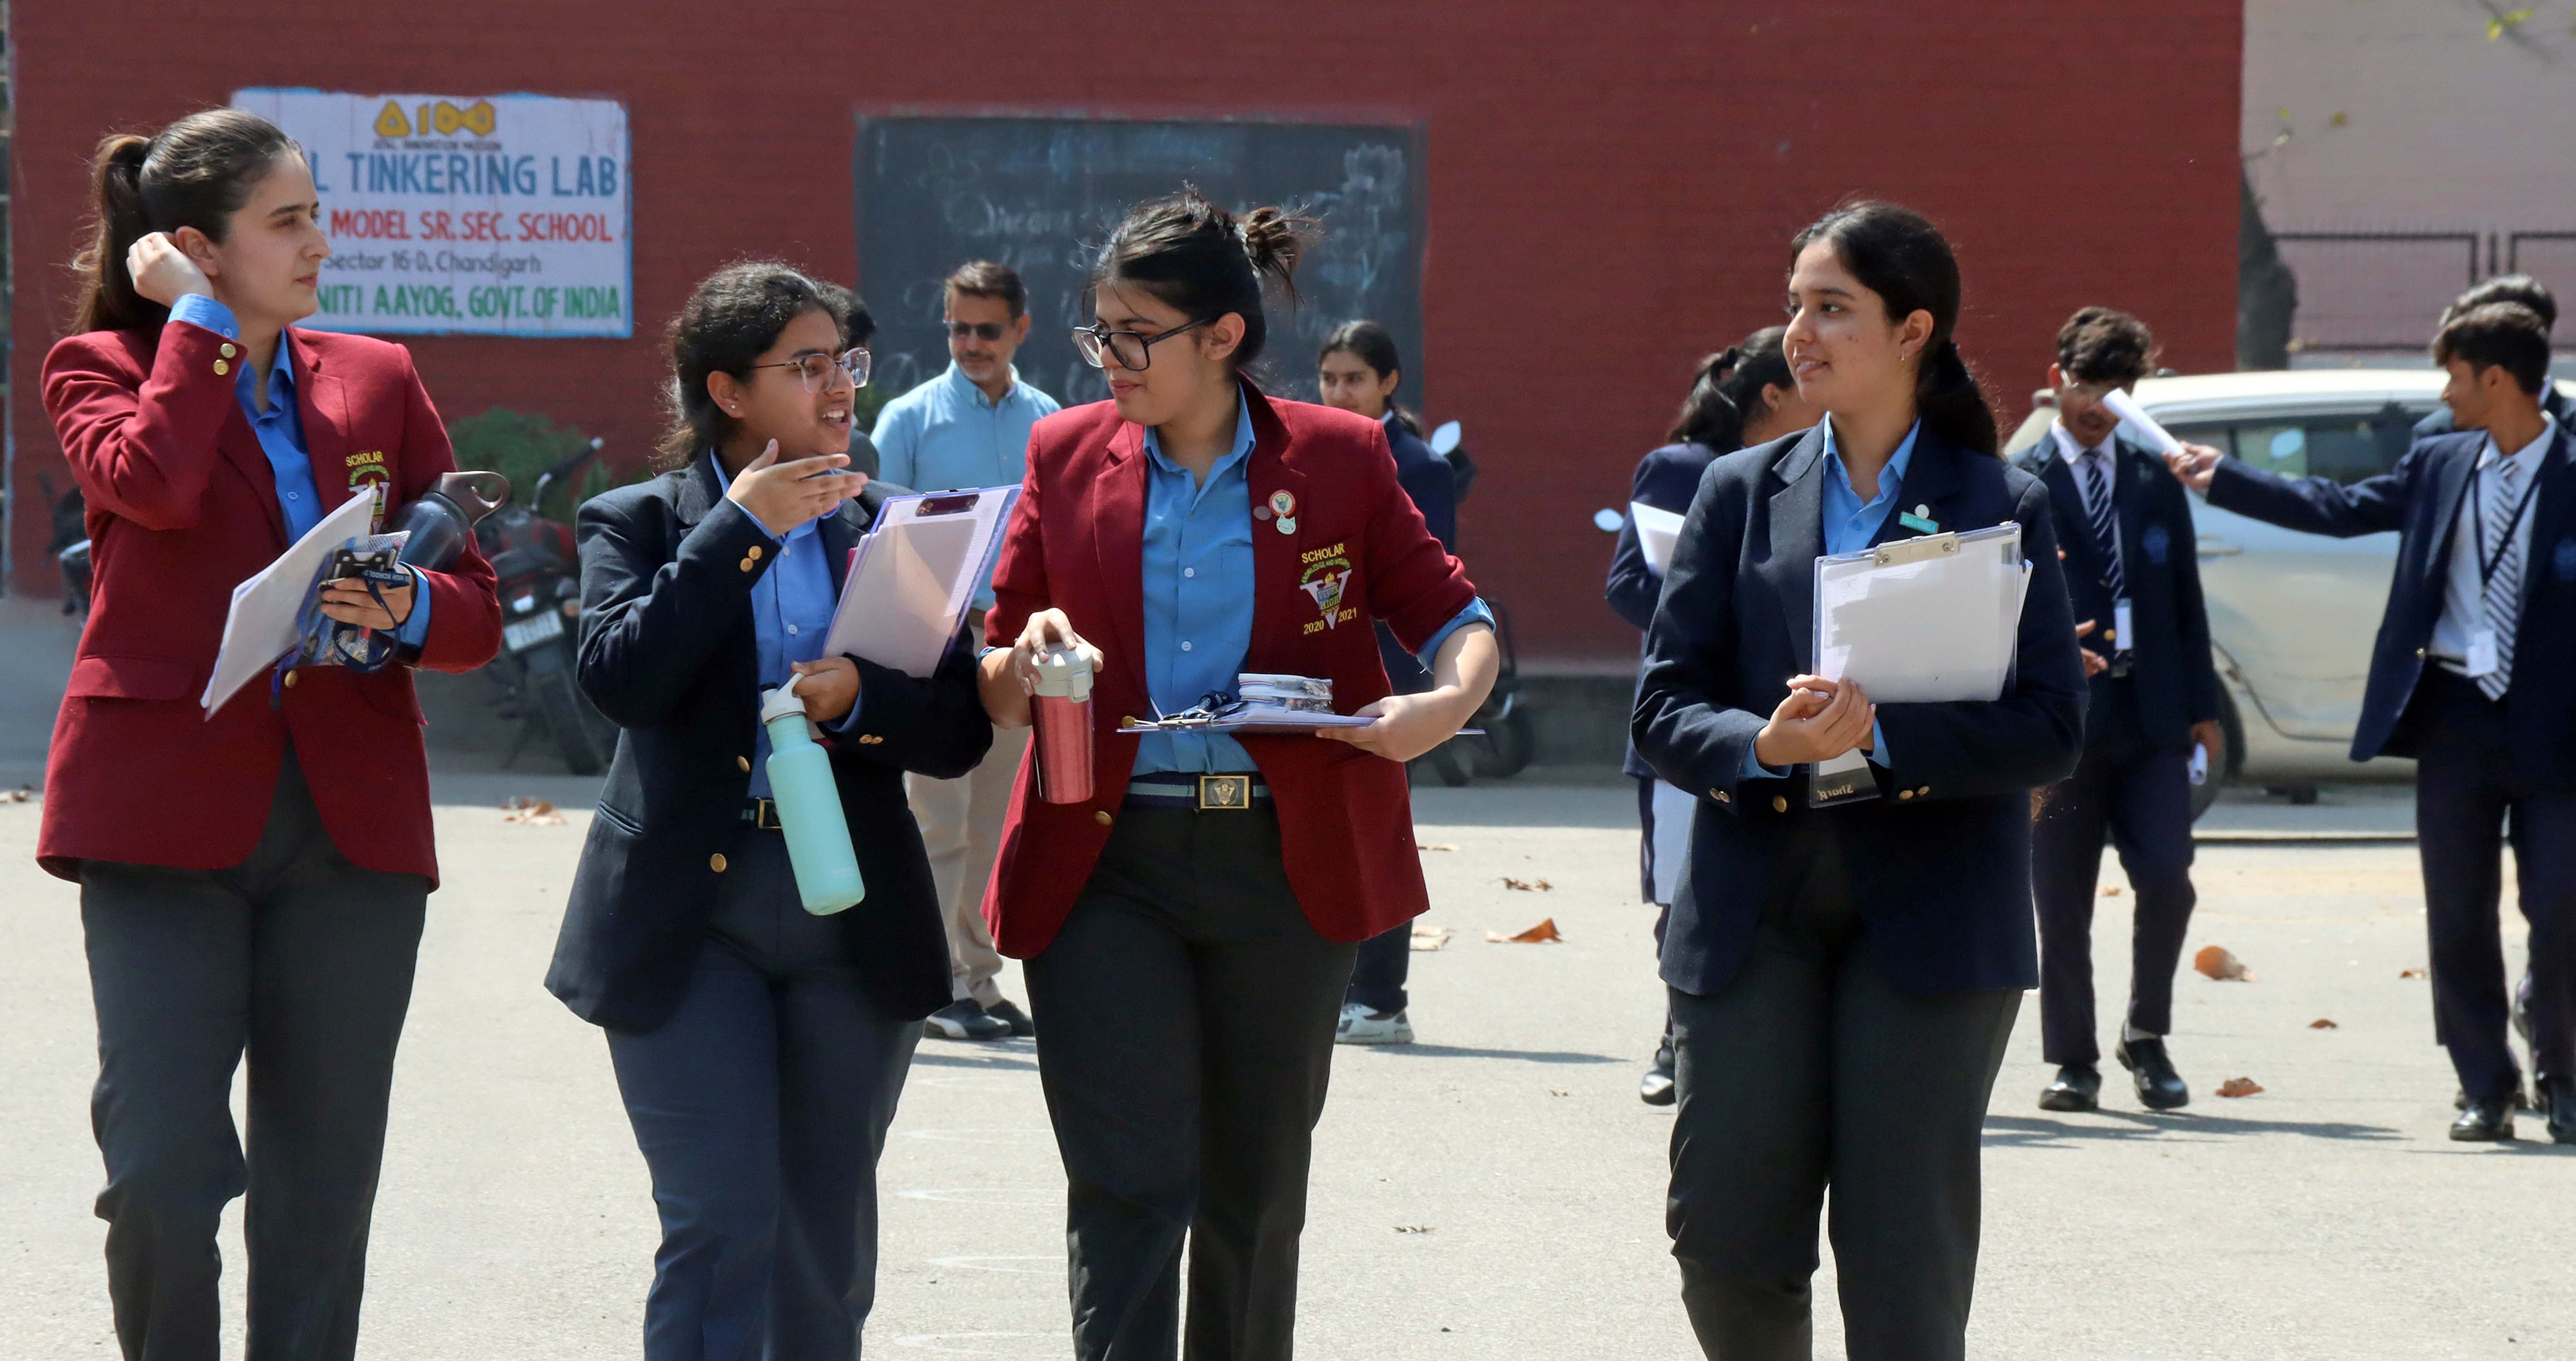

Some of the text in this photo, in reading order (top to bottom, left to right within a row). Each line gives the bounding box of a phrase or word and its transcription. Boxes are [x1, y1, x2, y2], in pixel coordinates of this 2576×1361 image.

[345, 152, 536, 195] TINKERING
[551, 156, 617, 197] LAB
[331, 209, 412, 240] MODEL
[419, 210, 456, 241] SR.
[518, 212, 614, 243] SCHOOL
[436, 249, 541, 279] Chandigarh
[317, 285, 363, 315] NITI
[533, 286, 557, 318] OF
[564, 285, 620, 318] INDIA
[346, 451, 383, 467] SCHOLAR
[1301, 543, 1345, 563] SCHOLAR
[1303, 607, 1357, 635] 2020 2021
